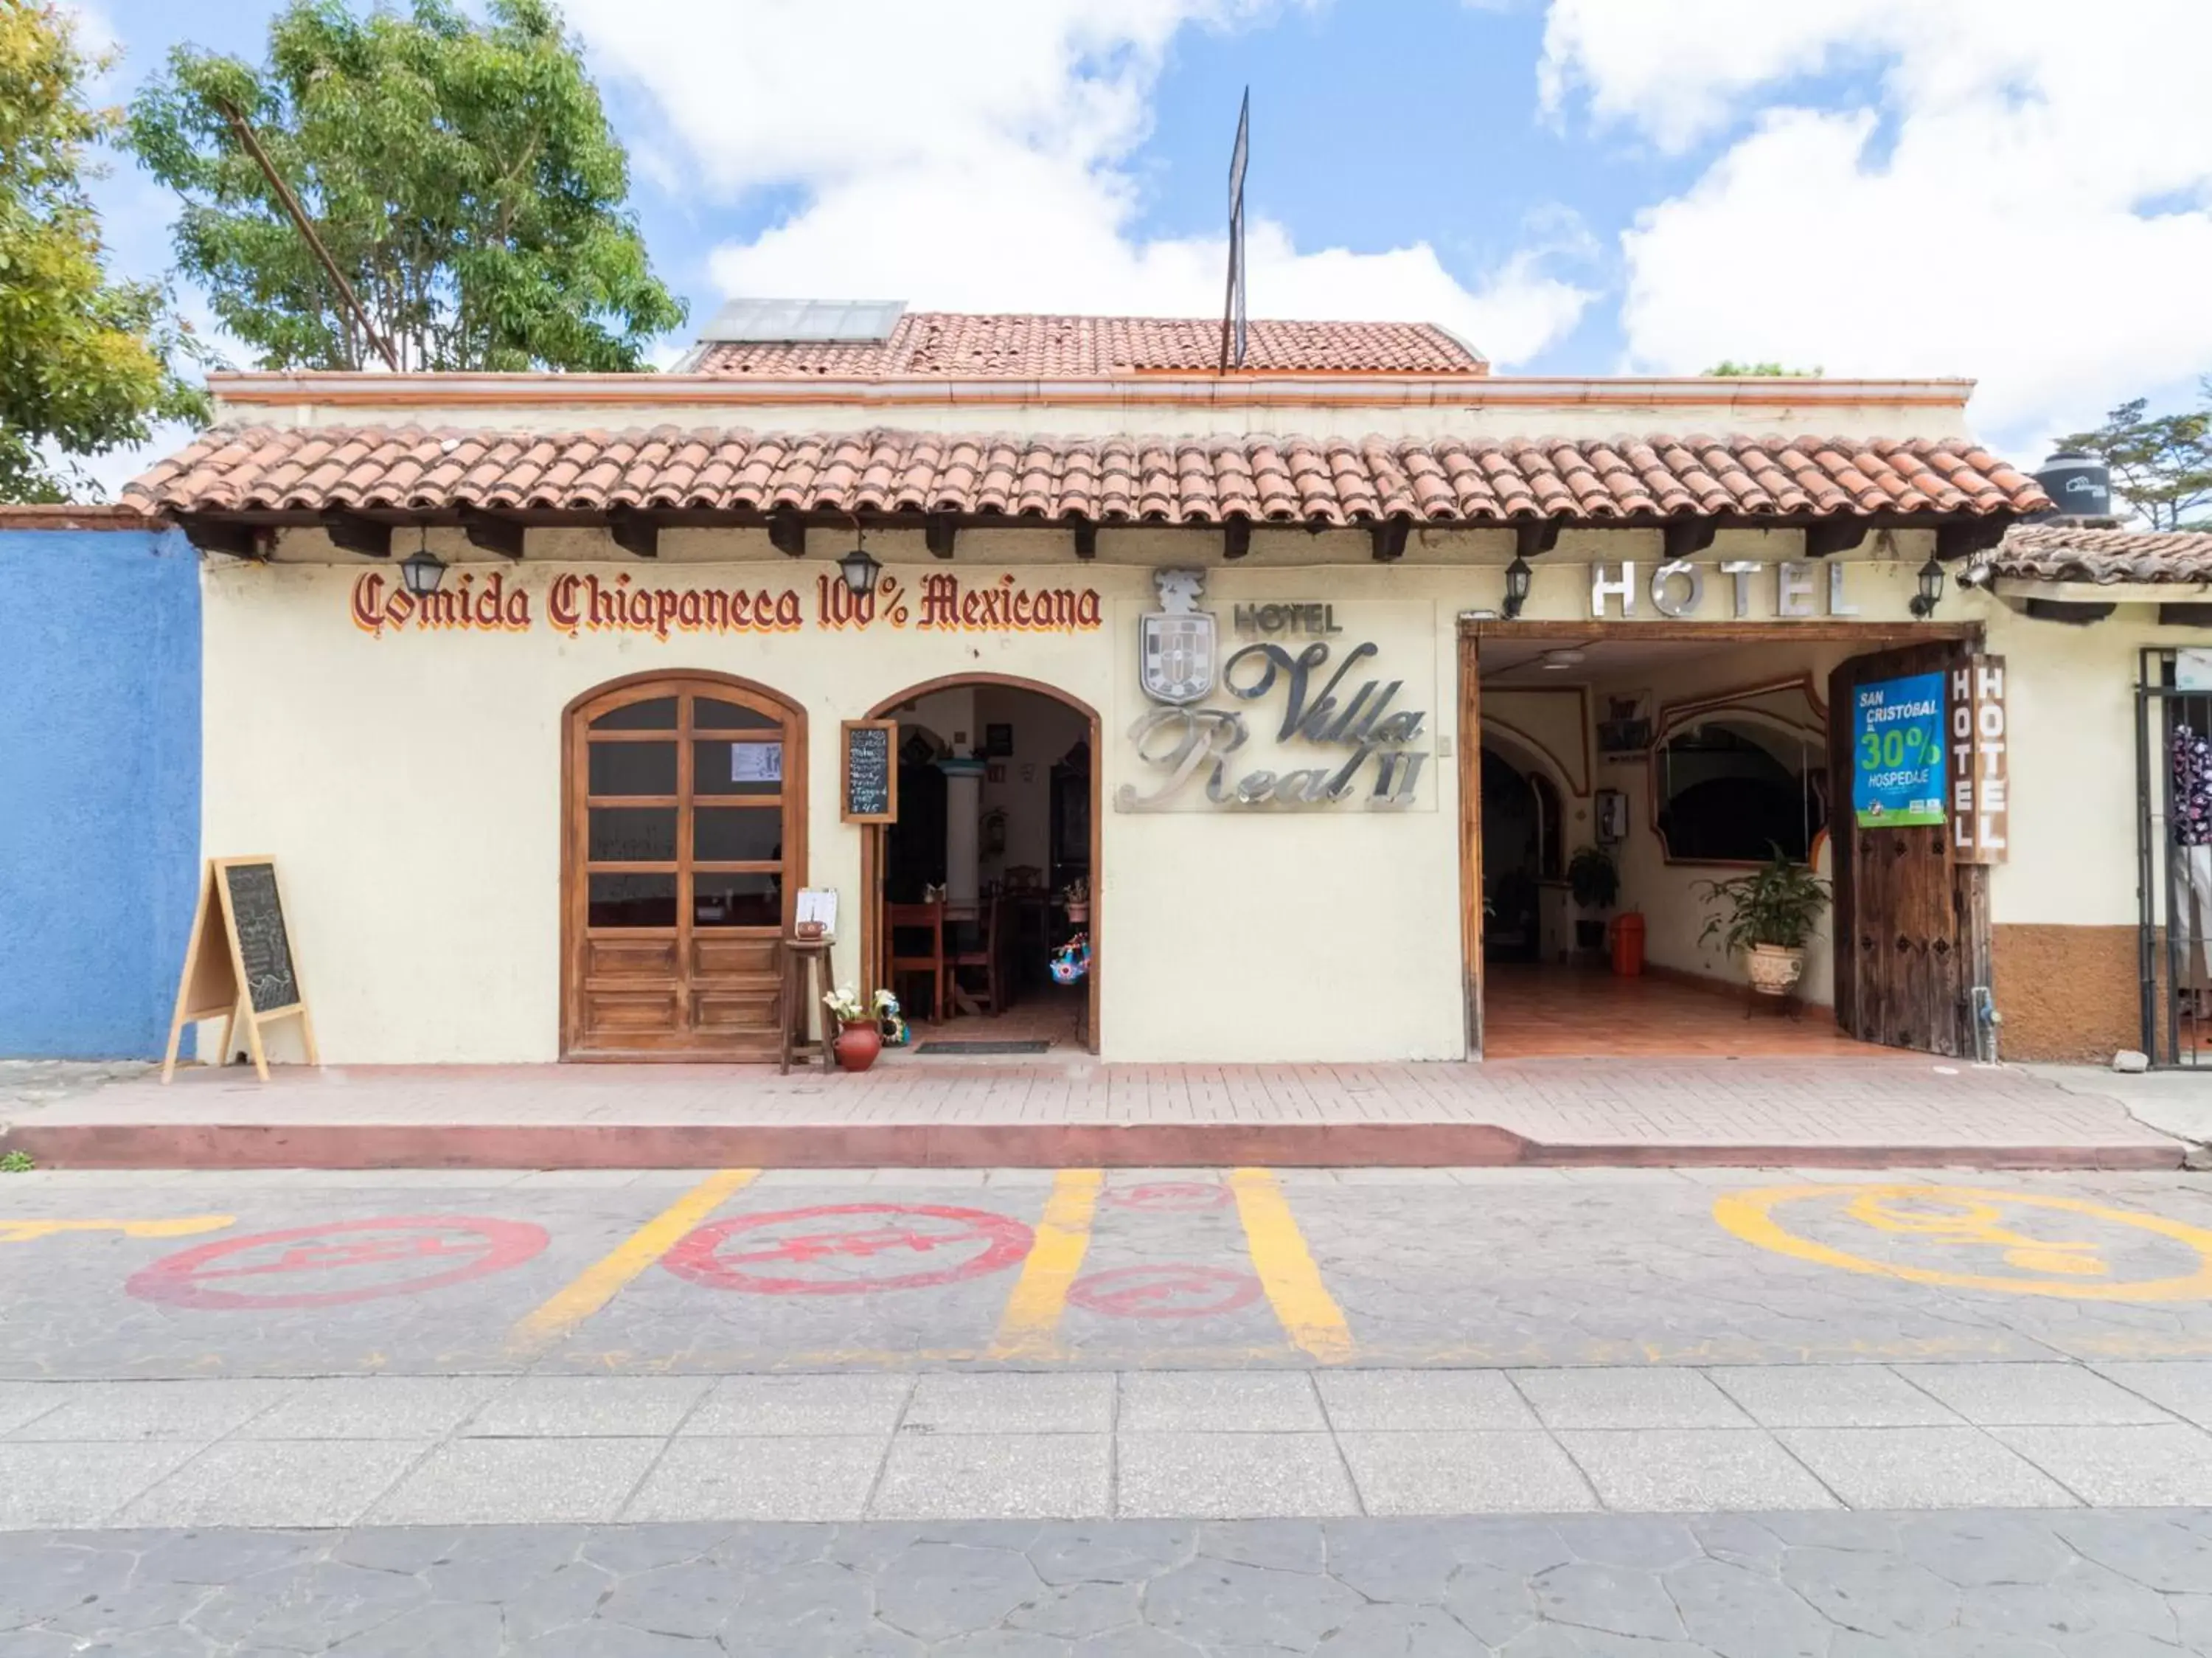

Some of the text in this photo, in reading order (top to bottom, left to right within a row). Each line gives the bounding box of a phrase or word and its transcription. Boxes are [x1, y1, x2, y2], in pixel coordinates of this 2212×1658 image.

[353, 571, 1103, 642] Comida Chiapaneca 100% Mexicana
[1234, 603, 1343, 636] HOTEL
[1591, 561, 1859, 617] HOTEL
[1224, 642, 1427, 744] Villa
[1860, 690, 1884, 707] SAN
[1116, 706, 1382, 808] Real
[1860, 726, 1941, 770] 30%
[1953, 669, 1972, 847] HOTEL
[1978, 667, 2006, 848] HOTEL
